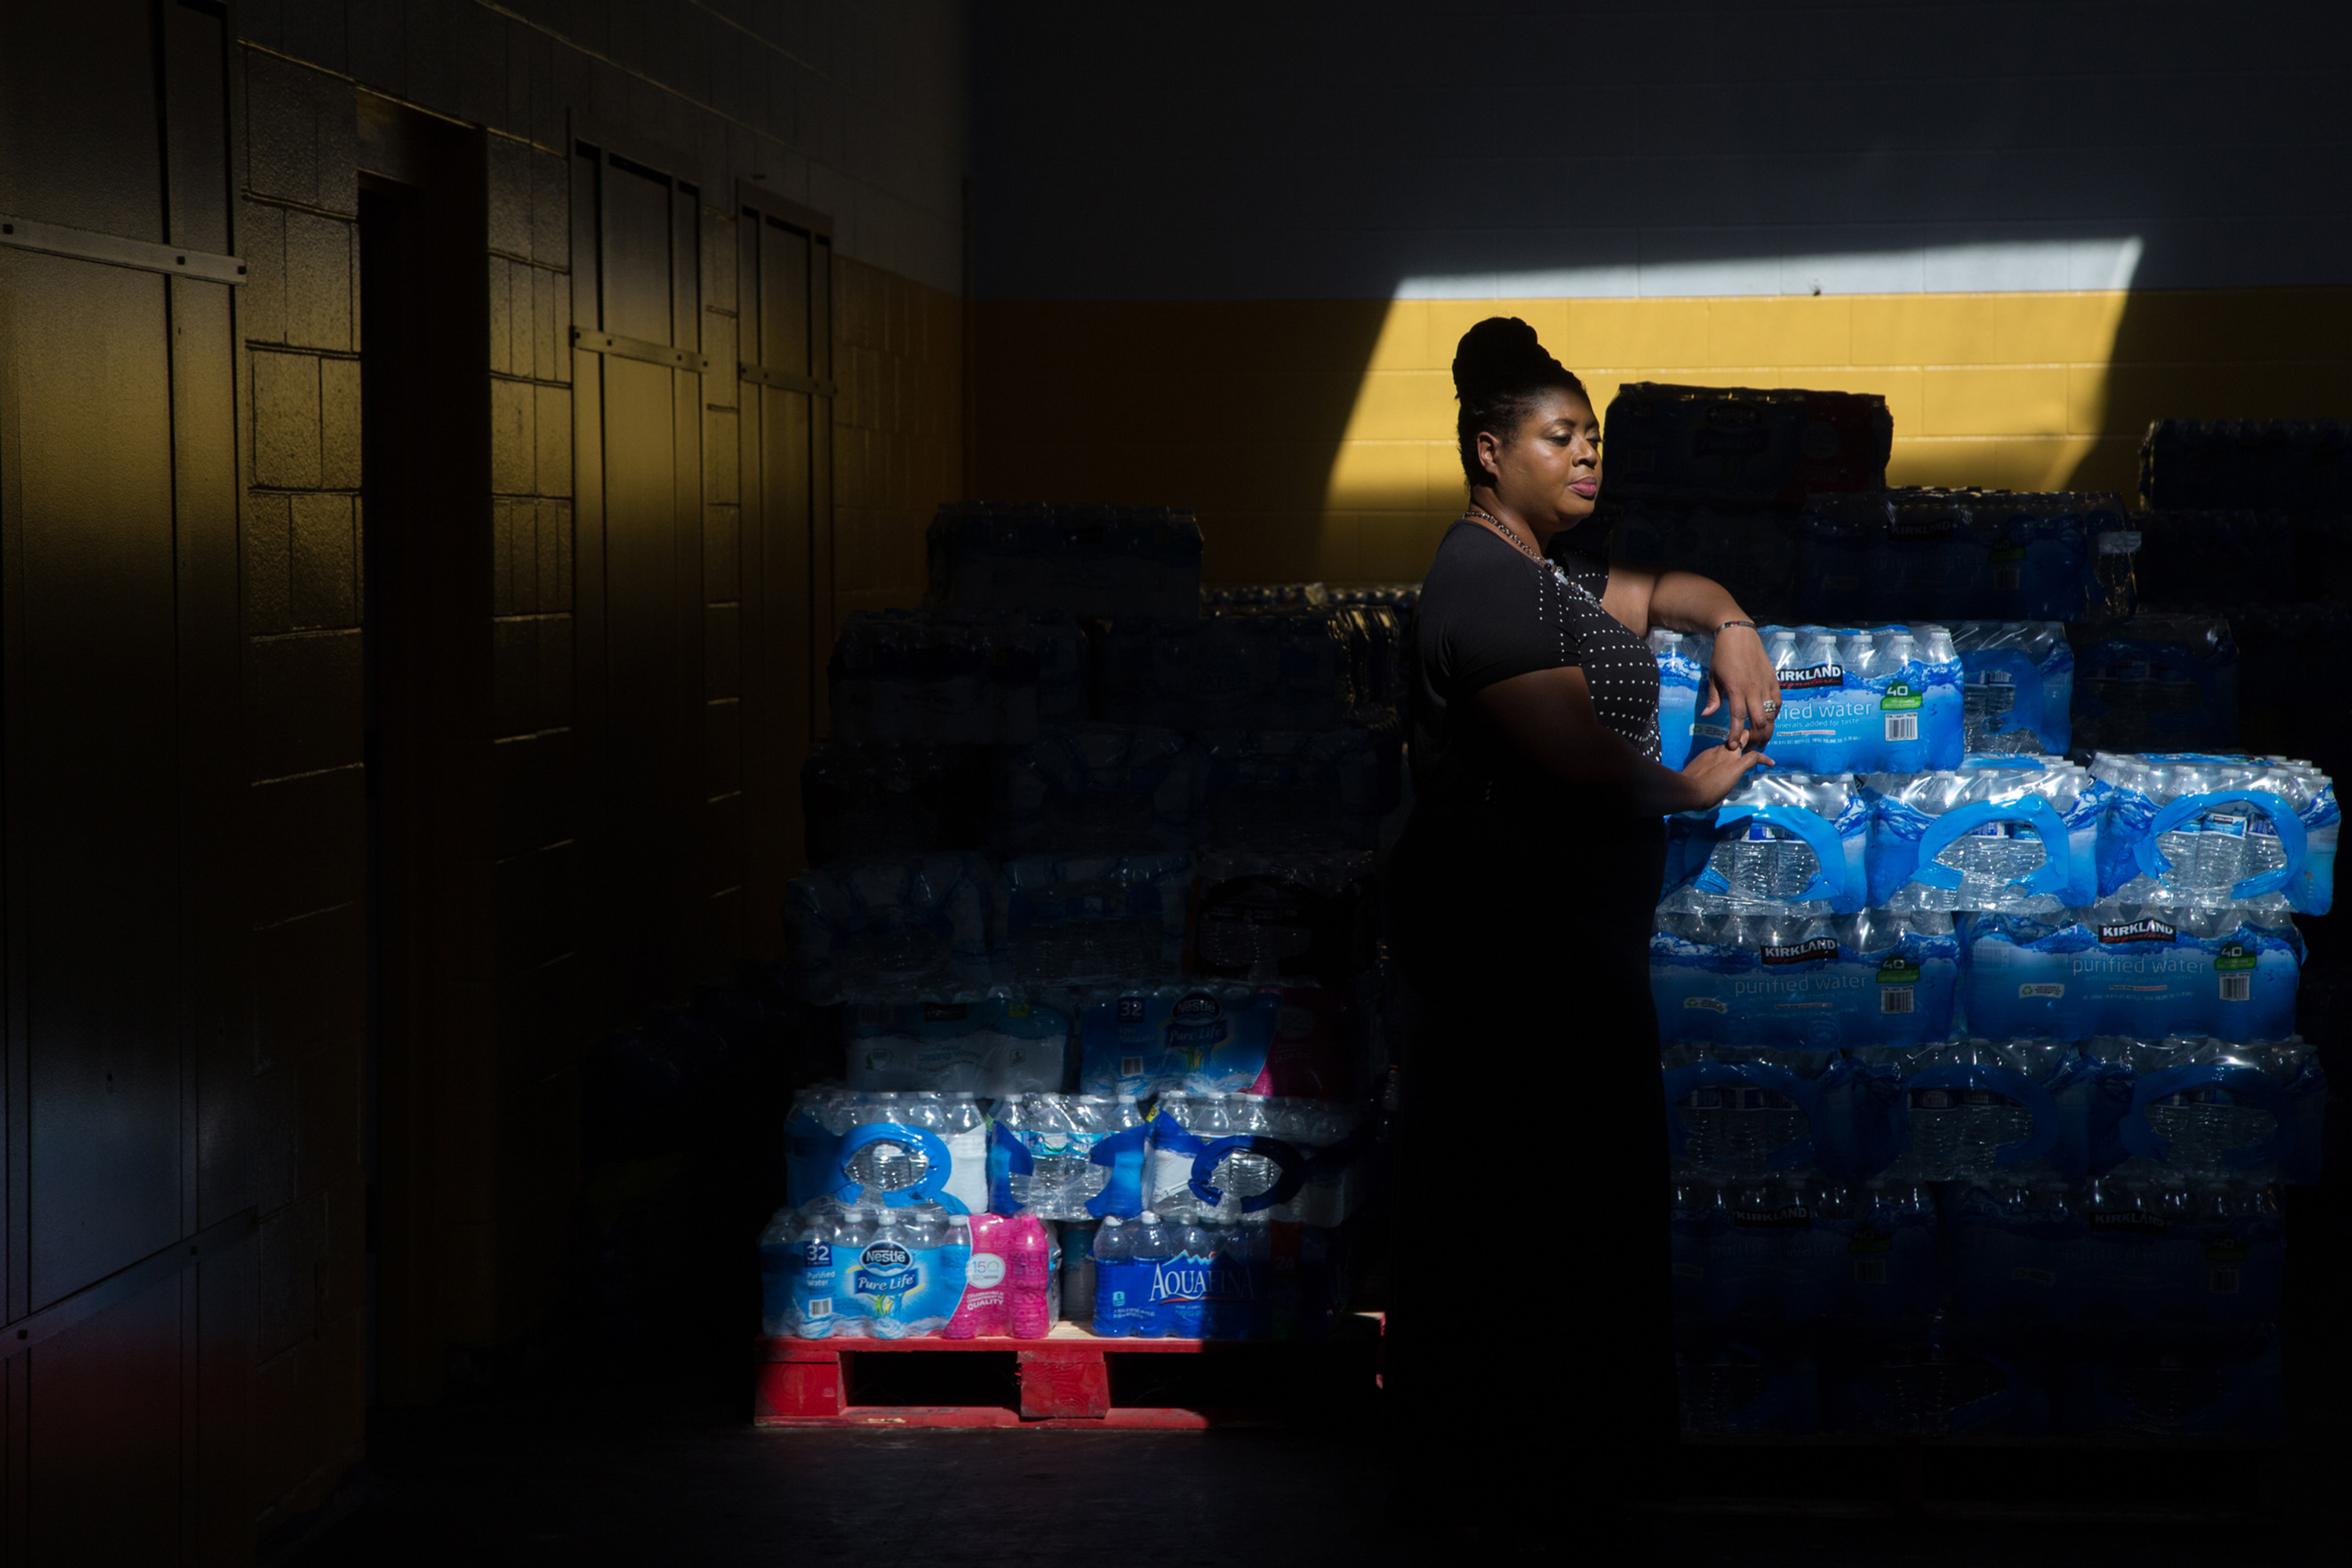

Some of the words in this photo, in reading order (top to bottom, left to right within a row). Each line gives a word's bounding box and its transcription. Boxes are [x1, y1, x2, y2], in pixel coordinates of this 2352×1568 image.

[1776, 666, 1842, 681] KIRKLAND
[1886, 685, 1908, 696] 40
[1818, 702, 1872, 718] water
[1805, 719, 1828, 728] added
[1829, 719, 1840, 728] for
[2103, 919, 2174, 937] KIRKLAND
[1764, 939, 1836, 958] KIRKLAND
[2220, 946, 2242, 957] 40
[1882, 959, 1905, 970] 40
[2072, 956, 2146, 977] purified
[2151, 958, 2206, 975] water
[1734, 975, 1809, 998] purified
[1815, 975, 1867, 991] water
[1120, 1000, 1143, 1017] 32
[806, 1245, 830, 1261] 32
[807, 1270, 836, 1279] Purified
[858, 1276, 887, 1290] Pure
[889, 1274, 914, 1290] Life
[1149, 1262, 1255, 1301] AQUAFINA
[967, 1299, 1004, 1310] QUALITY
